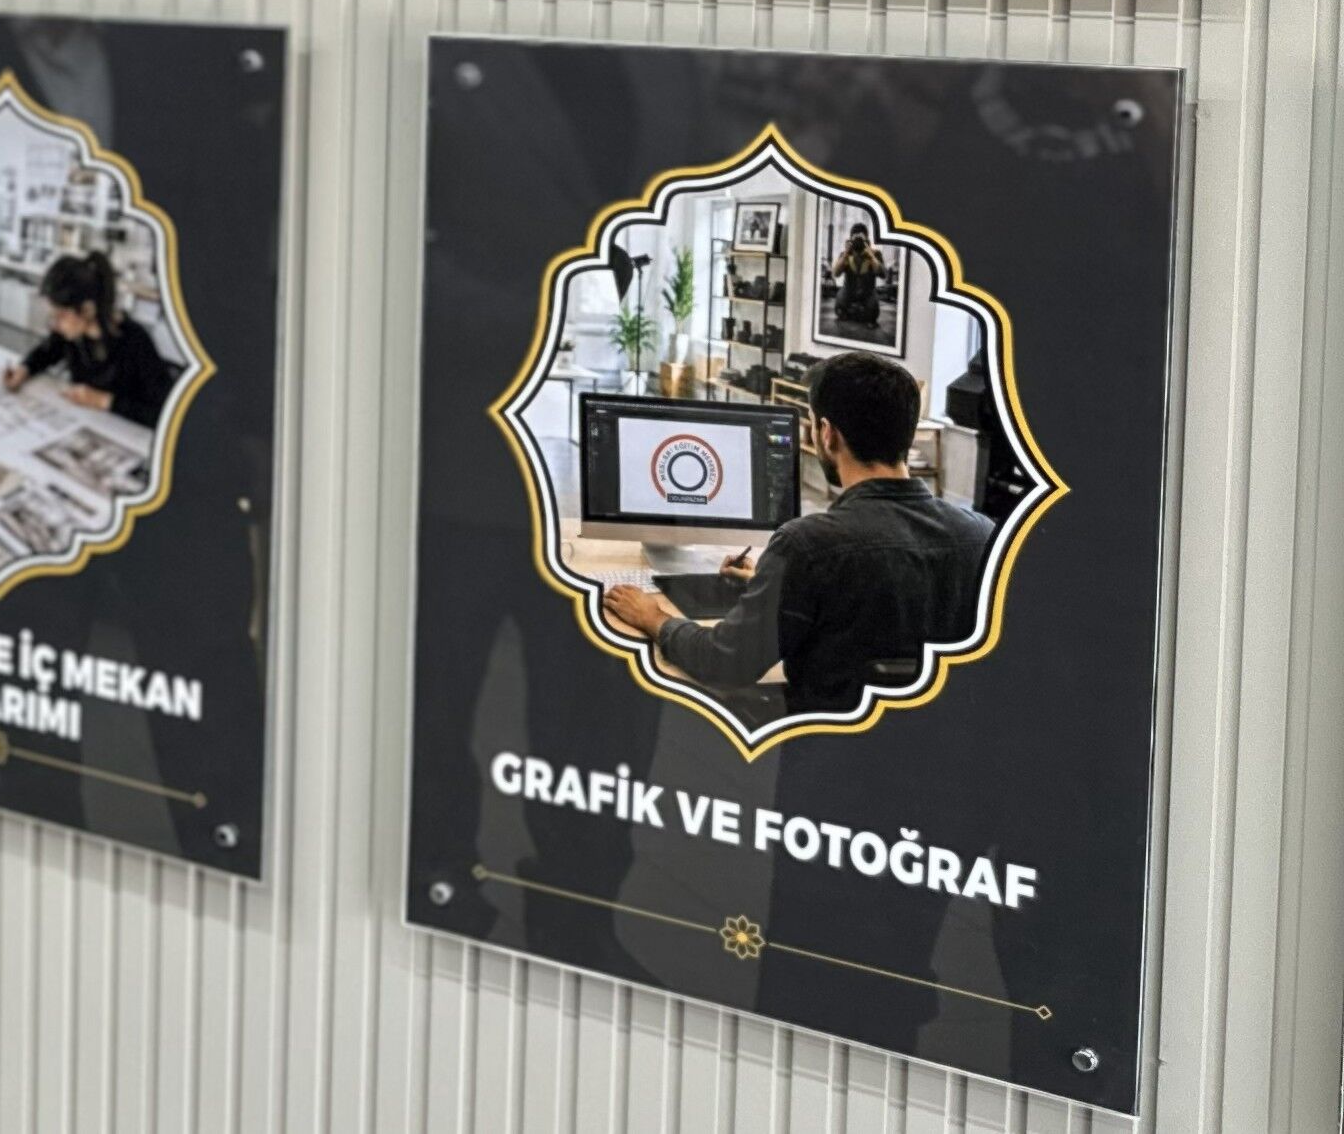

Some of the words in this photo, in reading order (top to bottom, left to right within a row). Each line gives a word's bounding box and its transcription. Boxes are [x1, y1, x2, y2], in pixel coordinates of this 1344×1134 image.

[15, 628, 57, 690] İÇ
[60, 650, 203, 721] MEKAN
[491, 751, 665, 829] GRAFİK
[675, 790, 741, 846] VE
[754, 807, 1038, 910] FOTOĞRAF
